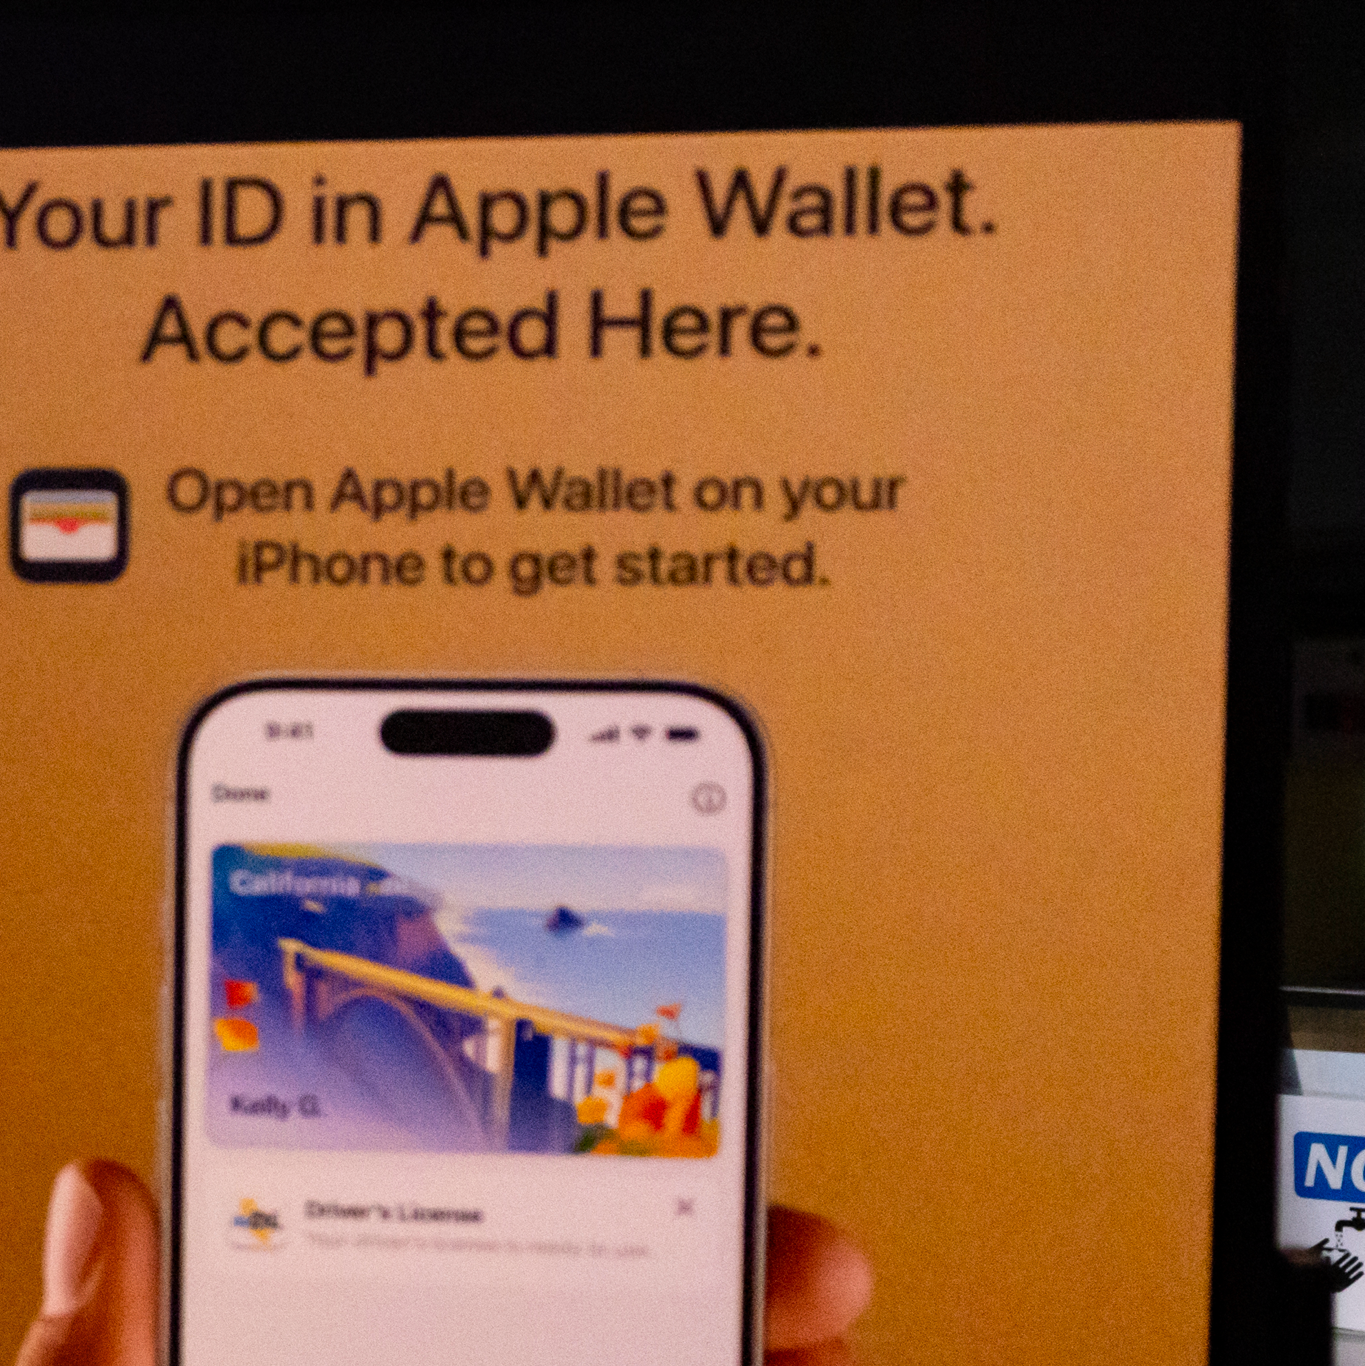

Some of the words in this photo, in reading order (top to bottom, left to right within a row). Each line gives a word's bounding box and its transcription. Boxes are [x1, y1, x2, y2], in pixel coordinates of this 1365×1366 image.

[197, 175, 284, 249] ID
[311, 174, 385, 246] in
[409, 168, 670, 260] Apple
[694, 164, 1000, 240] Wallet.
[139, 287, 561, 380] Accepted
[587, 285, 824, 361] Here.
[168, 467, 316, 524] Open
[329, 466, 492, 522] Apple
[505, 465, 678, 515] Wallet
[696, 472, 767, 516] on
[779, 472, 907, 524] your
[235, 538, 427, 589] iPhone
[440, 541, 496, 590] to
[507, 542, 598, 598] get
[614, 538, 831, 590] started.
[228, 867, 362, 897] California
